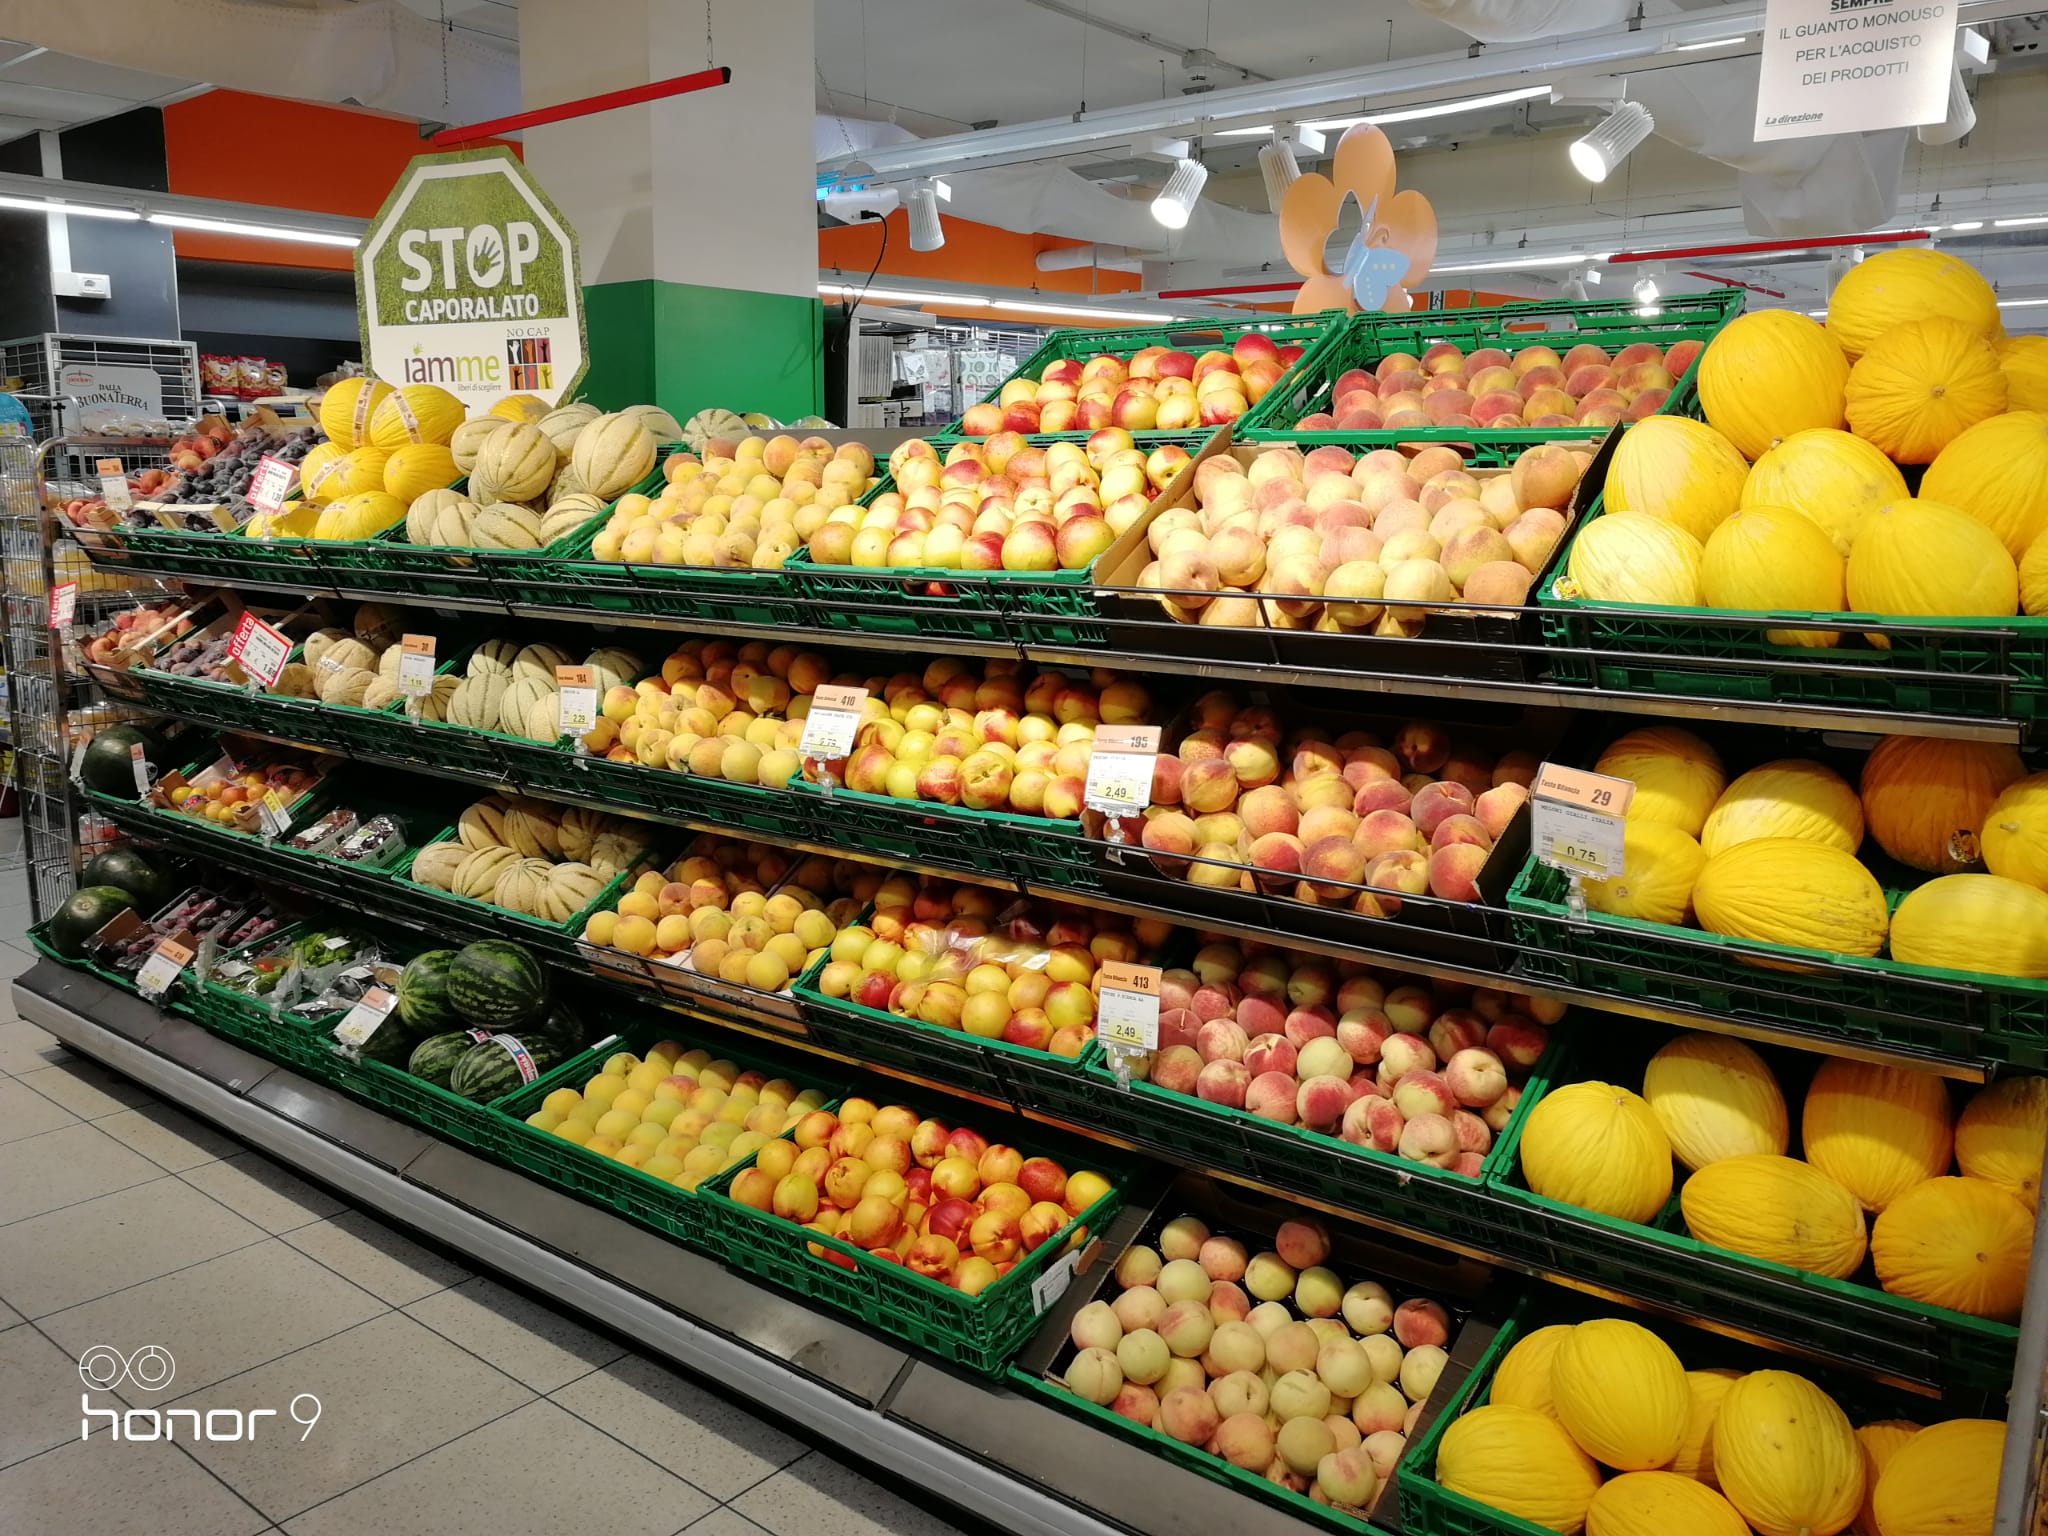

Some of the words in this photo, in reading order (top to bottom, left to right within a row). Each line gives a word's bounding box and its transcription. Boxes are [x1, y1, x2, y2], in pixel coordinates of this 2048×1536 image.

[1779, 28, 1791, 40] IL
[1795, 17, 1859, 38] GUANTO
[1862, 5, 1945, 28] MONOUSO
[1796, 47, 1825, 62] PER
[1830, 34, 1921, 58] L'ACQUISTO
[1802, 71, 1826, 86] DEI
[1831, 60, 1909, 82] PRODOTTI
[1765, 115, 1777, 125] La
[1777, 111, 1824, 124] direzione
[398, 221, 539, 293] STOP
[405, 293, 539, 322] CAPORALATO
[507, 328, 524, 338] NO
[527, 327, 550, 337] CAP
[404, 346, 500, 383] iamme
[232, 617, 254, 656] offerta
[841, 695, 856, 706] 410
[1130, 736, 1148, 748] 195
[1105, 787, 1127, 798] 2,49
[1591, 788, 1612, 806] 29
[1567, 846, 1596, 862] 0,75
[1133, 976, 1149, 988] 413
[1116, 1025, 1136, 1038] 2,49
